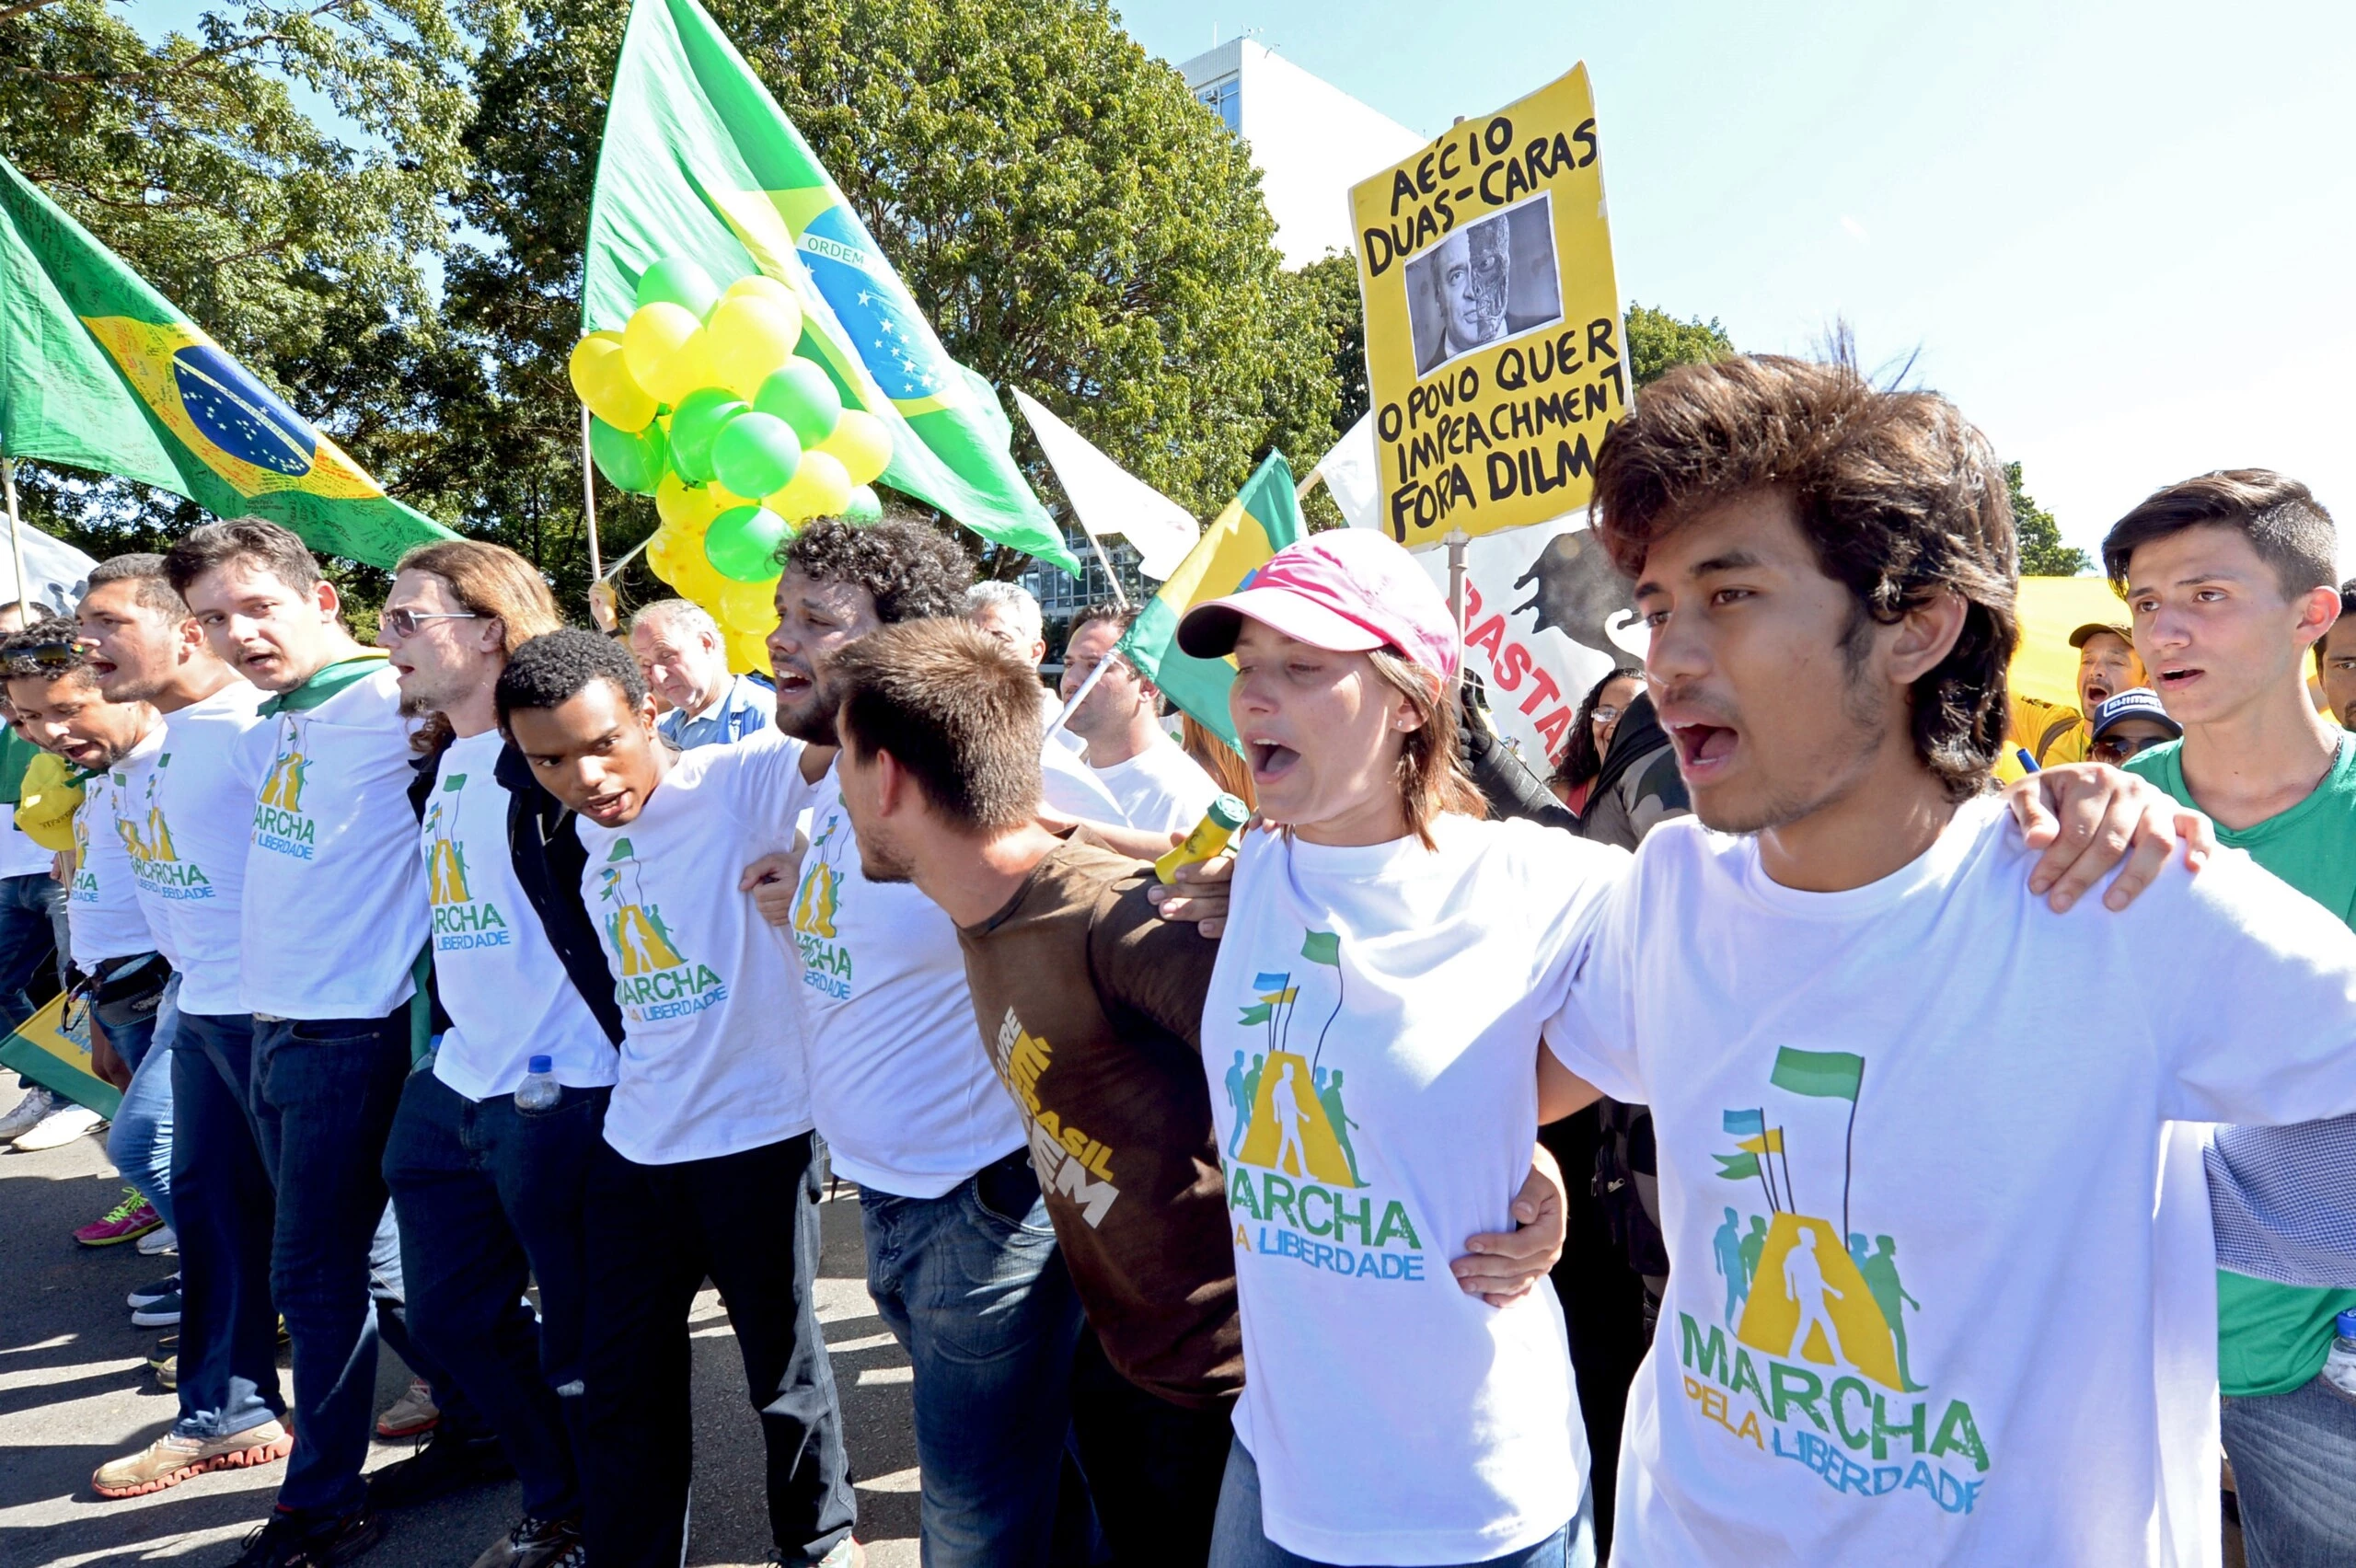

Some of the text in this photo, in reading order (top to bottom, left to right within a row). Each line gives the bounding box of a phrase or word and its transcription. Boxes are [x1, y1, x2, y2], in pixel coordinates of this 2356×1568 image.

[1363, 117, 1598, 277] DUAS-CARAS
[1391, 117, 1512, 216] AÉCIO
[808, 237, 864, 265] ORDEM
[1379, 318, 1618, 442] O POVO QUER
[1398, 362, 1624, 483] IMPEACHMENT
[1392, 419, 1614, 543] FORA DILM
[252, 804, 314, 844] ARCHA
[155, 862, 210, 886] RCHA
[432, 903, 506, 934] RCHA
[641, 986, 728, 1021] LIBERDADE
[803, 971, 851, 1000] ERDADE
[1222, 1158, 1422, 1250] ARCHA
[1259, 1227, 1426, 1281] LIBERDADE
[1679, 1311, 1990, 1473] MARCHA
[1683, 1375, 1765, 1451] PELA
